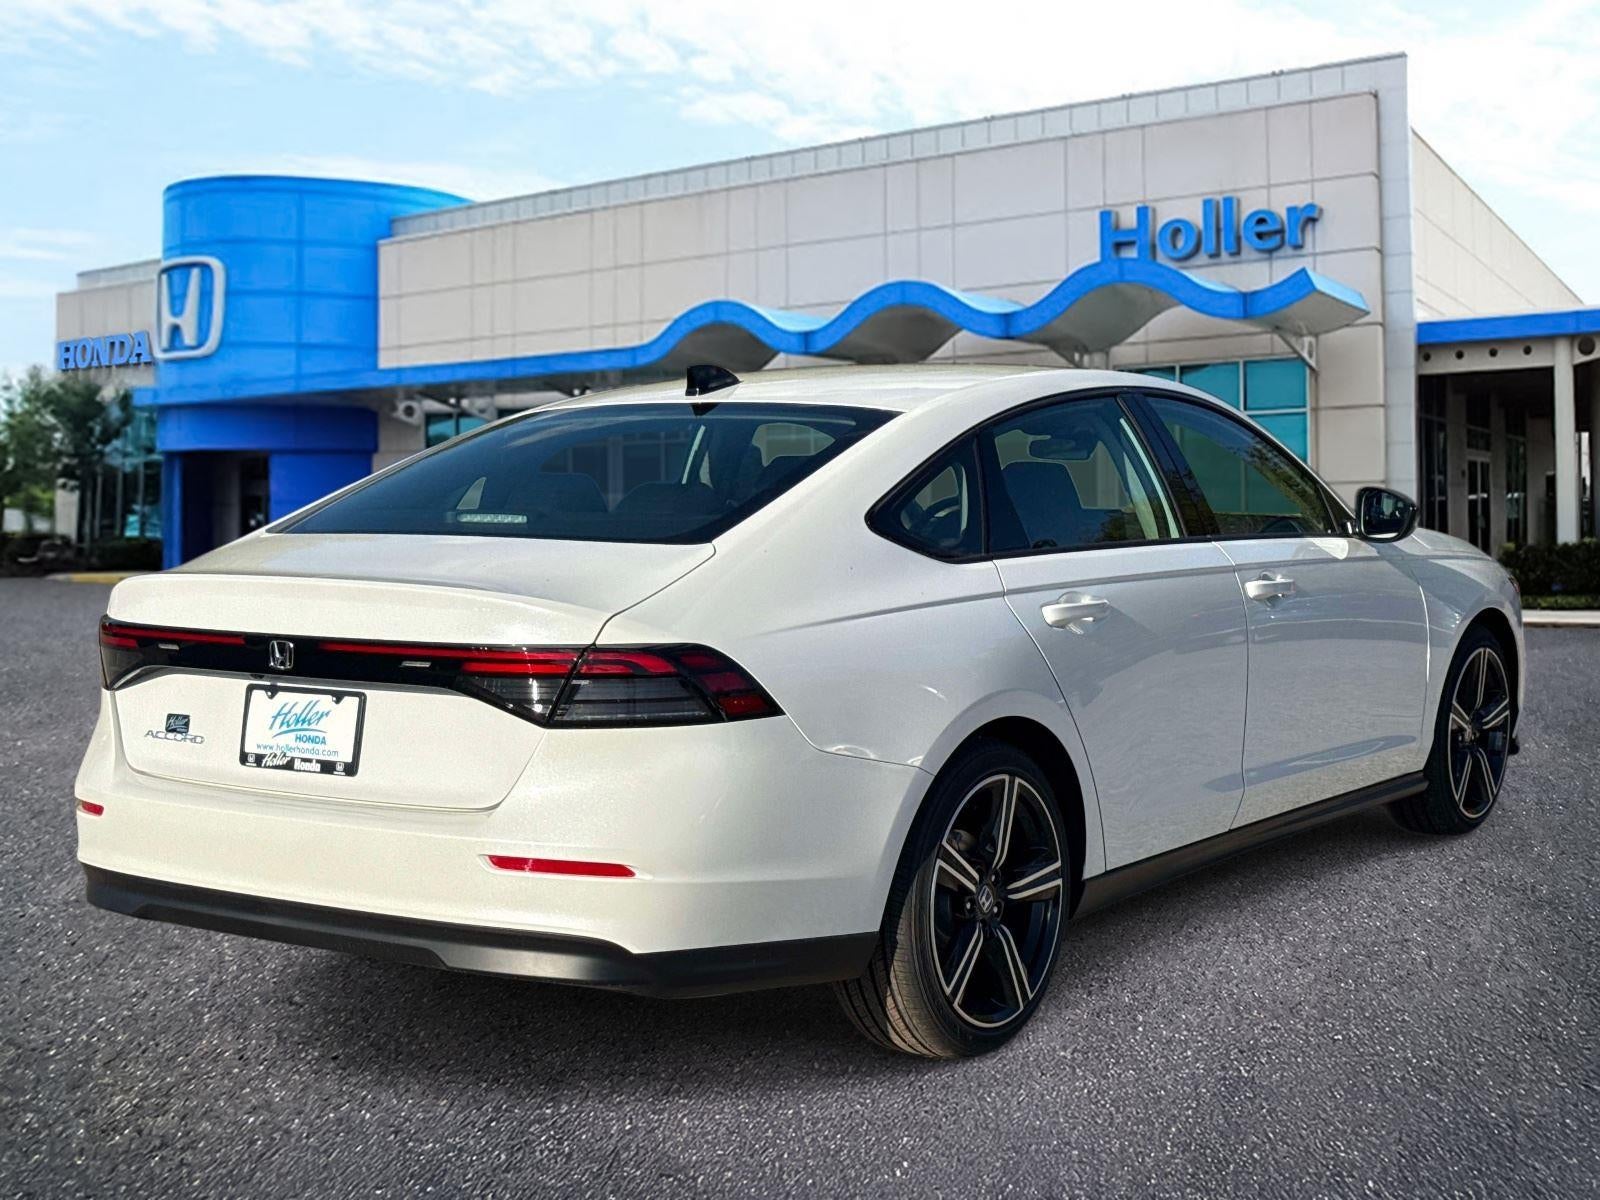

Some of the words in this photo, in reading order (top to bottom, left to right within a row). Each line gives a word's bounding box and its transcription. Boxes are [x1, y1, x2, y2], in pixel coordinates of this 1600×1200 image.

[1099, 196, 1322, 261] Holler
[57, 331, 152, 371] HONDA
[268, 699, 332, 731] Holler
[144, 729, 206, 744] ACCORD
[295, 734, 327, 746] HONDA
[256, 742, 339, 758] www.hollerhonda.com
[261, 751, 292, 768] Holler
[293, 758, 321, 772] Honda
